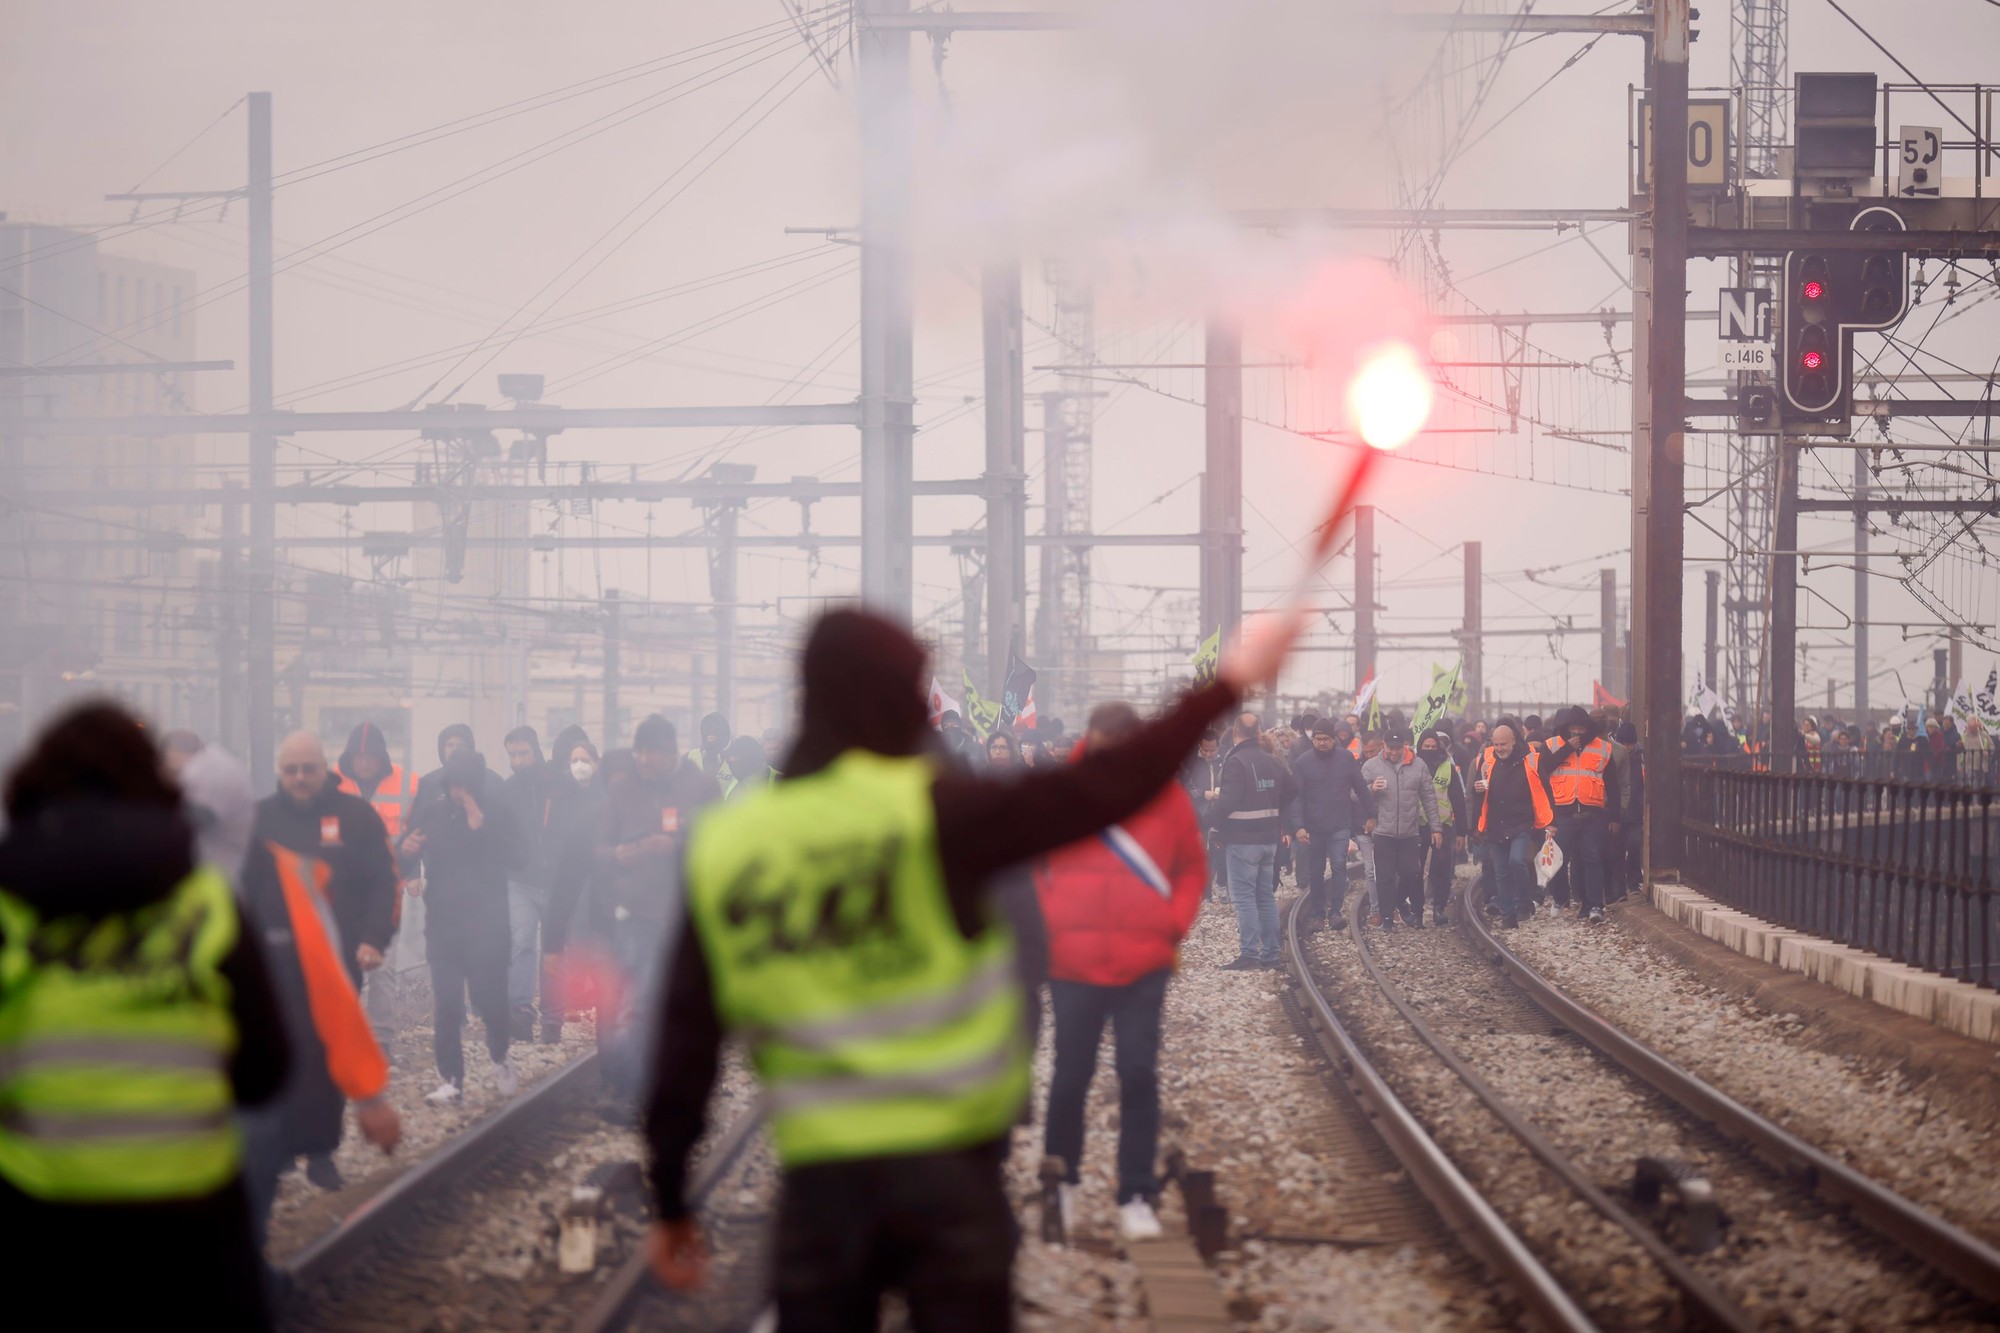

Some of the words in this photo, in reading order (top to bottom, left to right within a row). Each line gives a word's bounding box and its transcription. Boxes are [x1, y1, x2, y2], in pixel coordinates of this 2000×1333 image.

[1688, 120, 1713, 168] 0
[1903, 139, 1919, 165] 5
[1720, 291, 1770, 337] Nf
